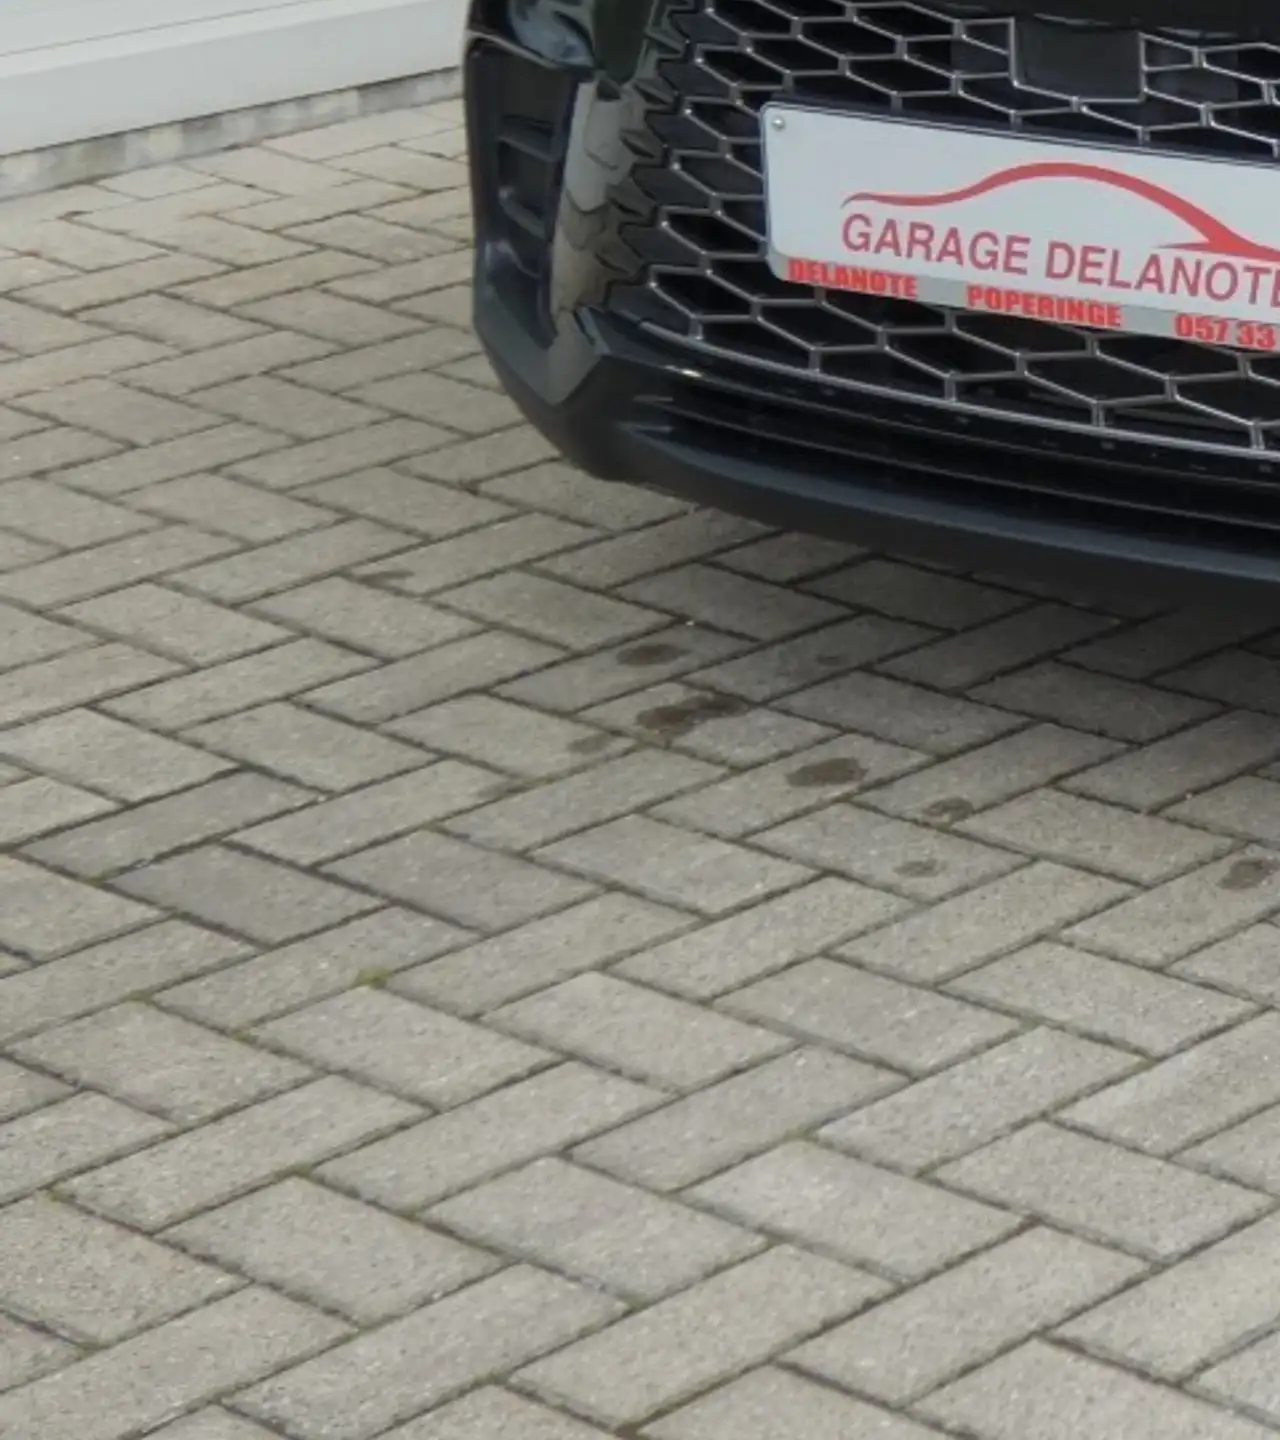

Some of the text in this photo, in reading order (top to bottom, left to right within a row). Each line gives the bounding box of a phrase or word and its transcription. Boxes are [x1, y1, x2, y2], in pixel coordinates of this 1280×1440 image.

[842, 213, 1030, 275] GARAGE
[788, 260, 917, 299] DELANOTE
[967, 285, 1122, 327] POPERINGE
[1175, 312, 1229, 342] 057
[1235, 321, 1276, 349] 33
